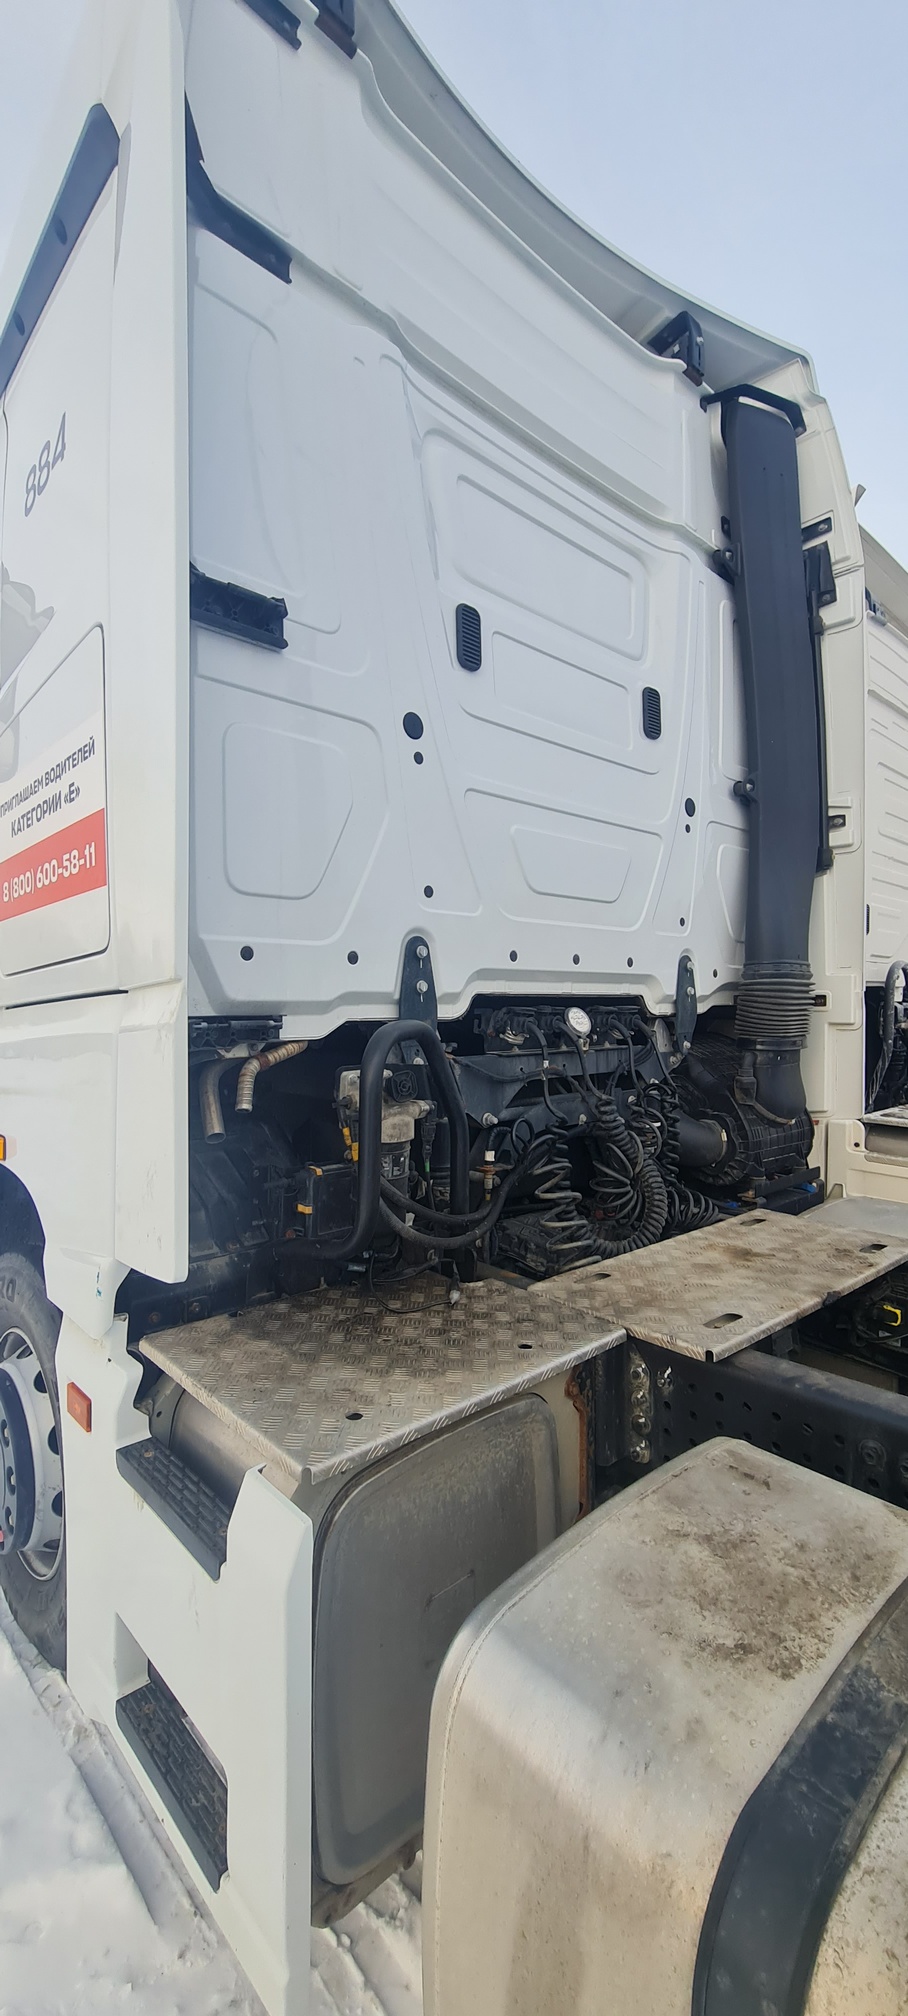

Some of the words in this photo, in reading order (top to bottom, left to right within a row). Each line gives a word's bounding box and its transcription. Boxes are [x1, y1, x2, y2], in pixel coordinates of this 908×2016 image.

[24, 411, 67, 518] 884
[0, 774, 44, 818] ПРИГЛАШАЕМ
[44, 735, 96, 788] ВОДИТЕЛЕЙ
[11, 790, 62, 838] КАТЕГОРИИ
[3, 881, 9, 903] 8
[10, 868, 35, 903] (800)
[36, 841, 96, 889] 600-58-11
